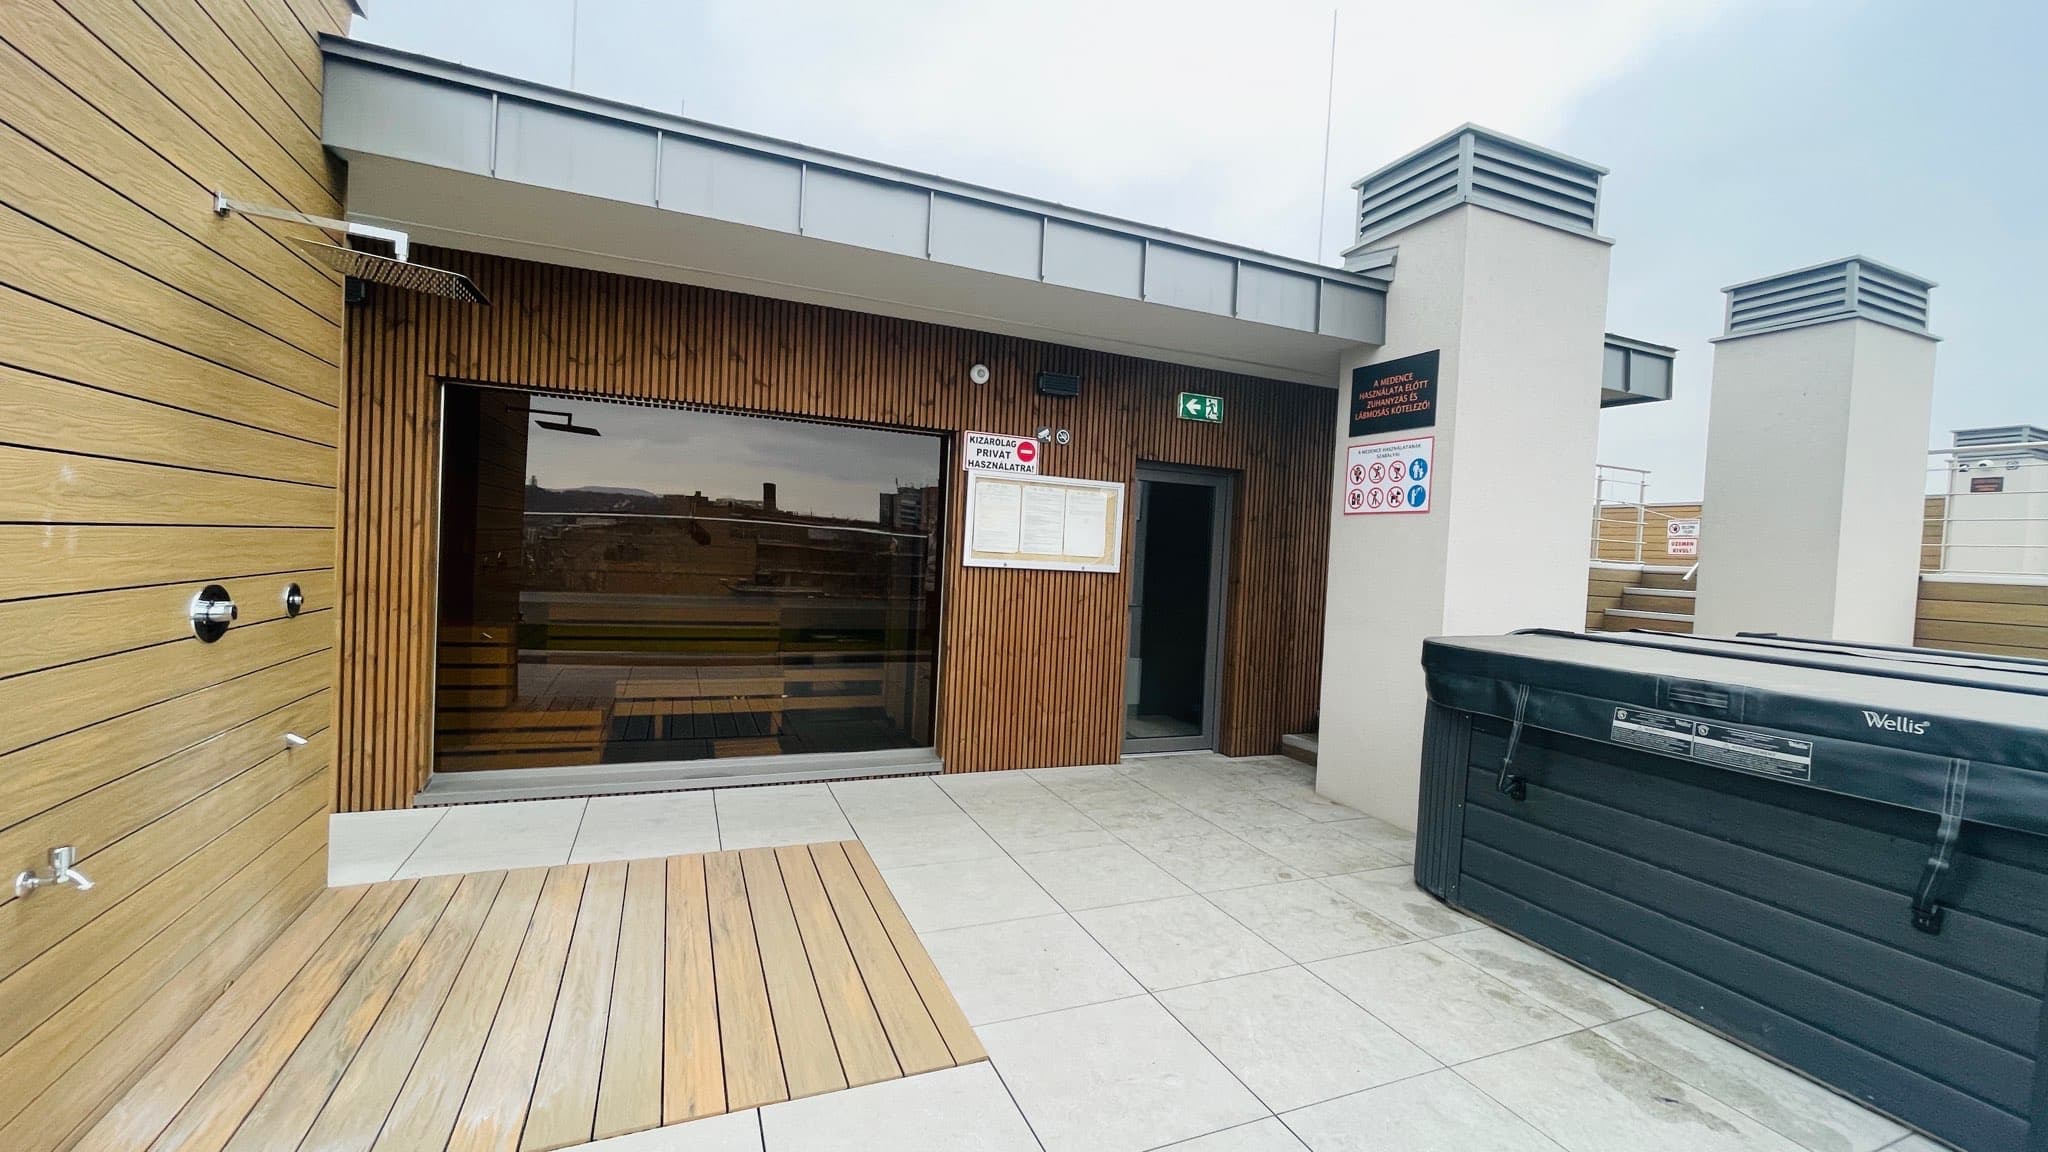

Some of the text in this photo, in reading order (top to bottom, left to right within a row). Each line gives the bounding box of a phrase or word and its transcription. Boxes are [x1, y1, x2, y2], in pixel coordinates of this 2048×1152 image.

[1380, 372, 1414, 386] MEDENCE
[1359, 379, 1429, 400] HASZNÁLATA ELŐTT
[1367, 391, 1418, 408] ZUHANYZÁS ÉS
[1355, 406, 1389, 420] LÁBMOSÁS
